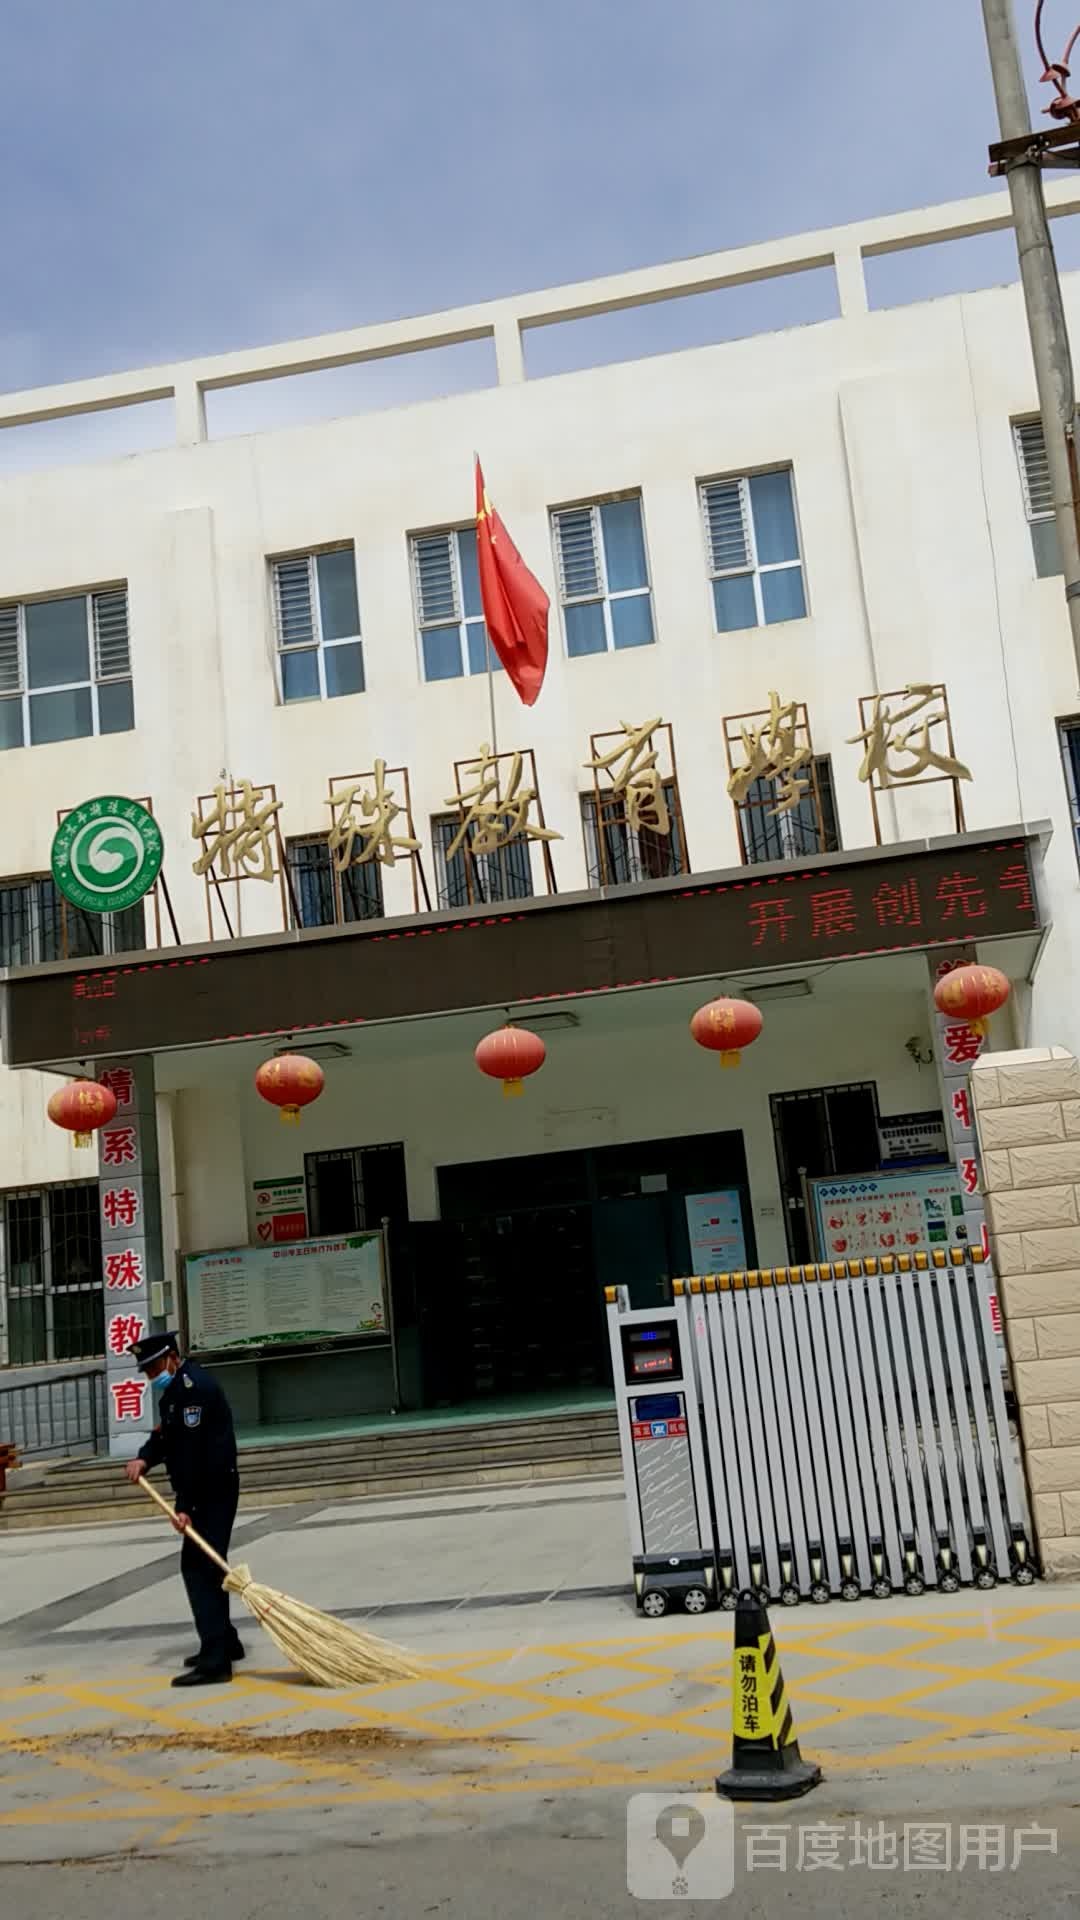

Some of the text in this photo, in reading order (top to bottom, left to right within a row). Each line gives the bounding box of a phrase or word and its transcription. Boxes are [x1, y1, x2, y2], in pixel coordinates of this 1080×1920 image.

[100, 1067, 147, 1420] 情系特殊教育
[739, 1653, 761, 1734] 请勿泊车
